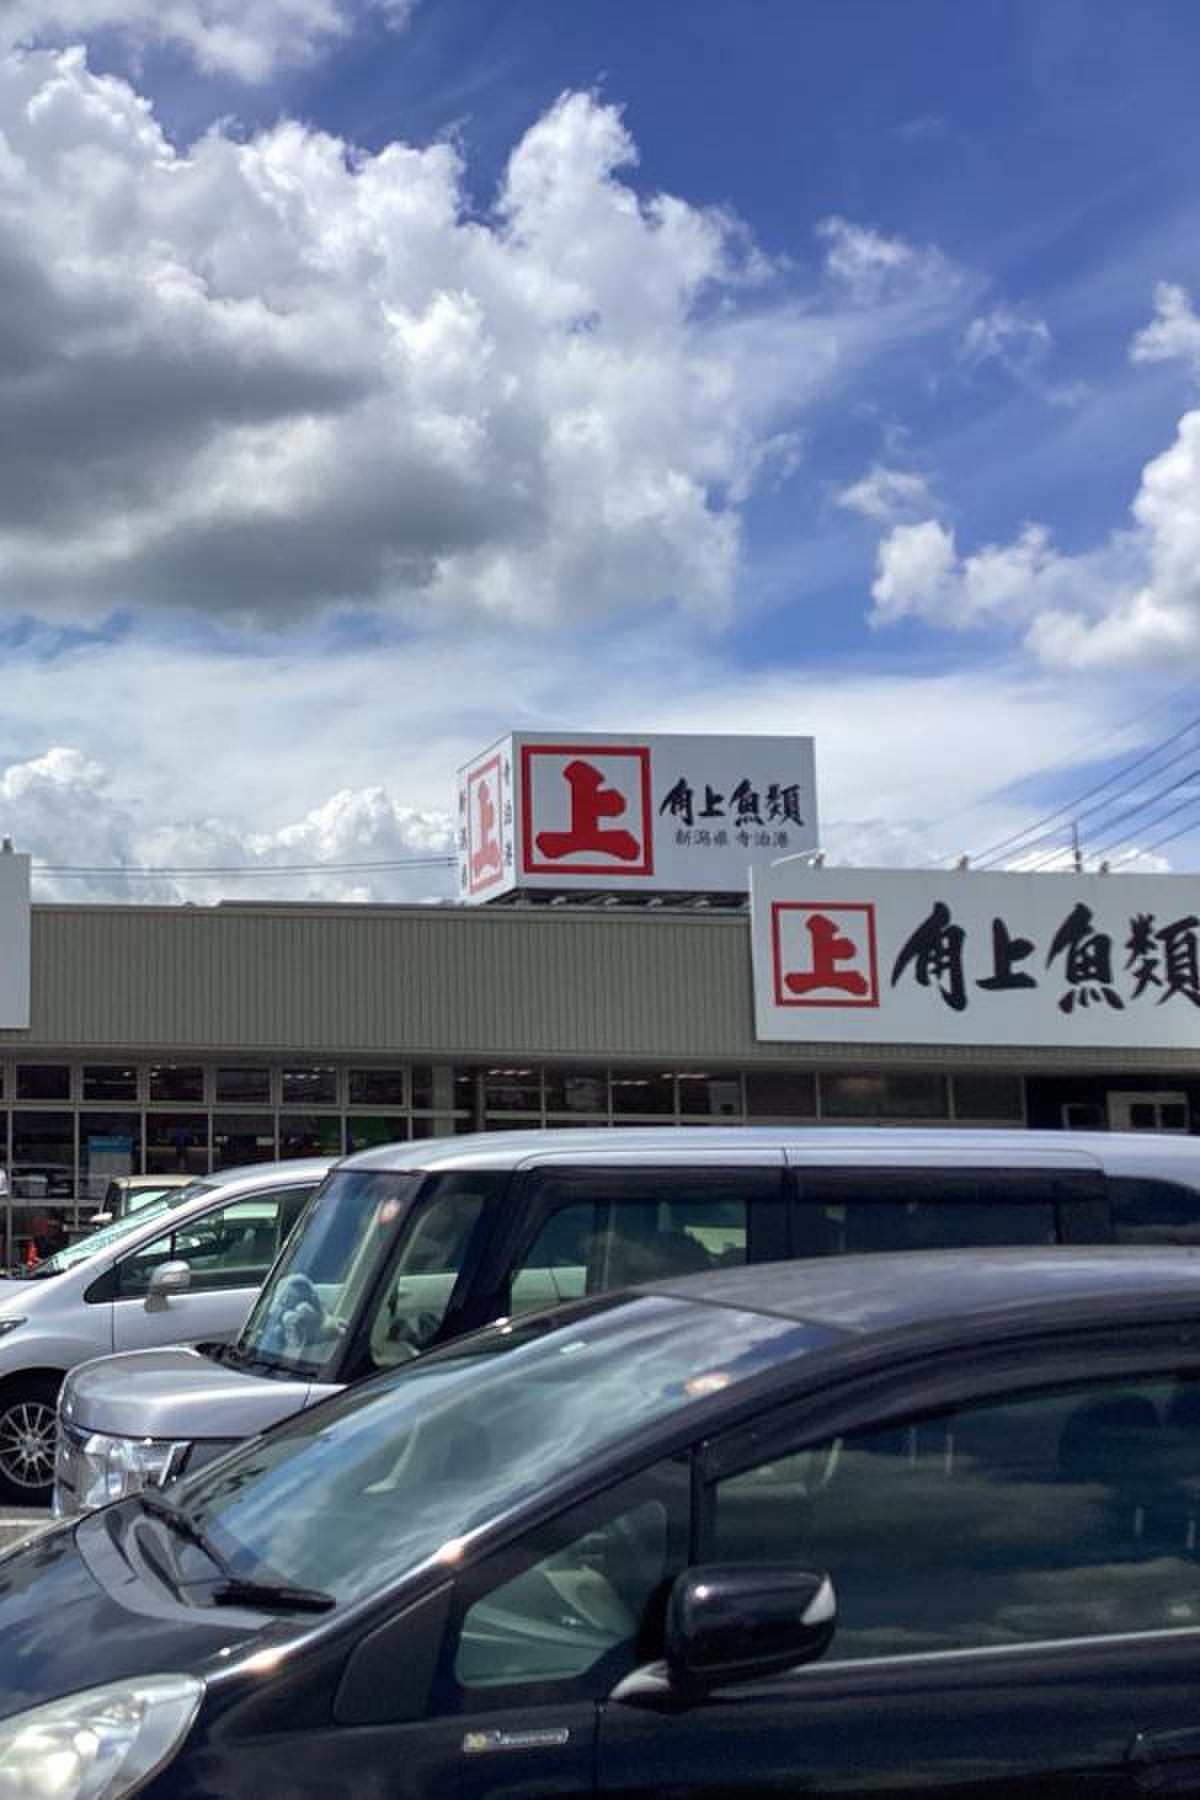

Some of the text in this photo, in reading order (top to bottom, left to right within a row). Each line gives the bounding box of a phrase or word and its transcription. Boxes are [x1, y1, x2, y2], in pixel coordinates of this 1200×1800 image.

[535, 760, 640, 861] 上
[659, 777, 806, 827] 角上魚類
[784, 901, 1200, 1013] 上 角上魚類
